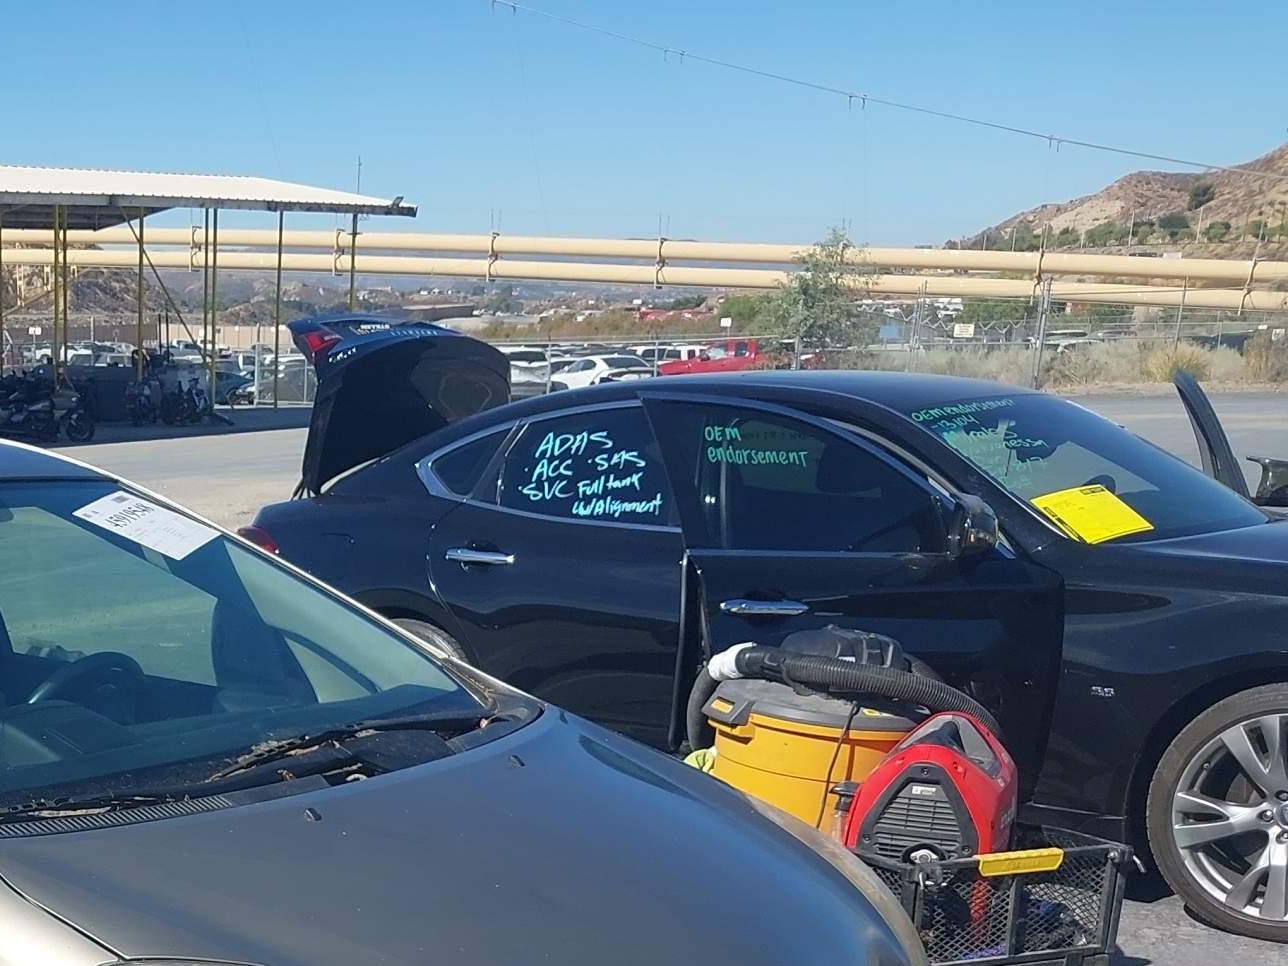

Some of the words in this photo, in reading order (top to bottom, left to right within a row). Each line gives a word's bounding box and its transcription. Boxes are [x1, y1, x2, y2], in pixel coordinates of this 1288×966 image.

[535, 431, 613, 458] ADAS
[704, 426, 742, 442] OEM
[531, 458, 574, 482] ACC
[594, 450, 646, 471] SAS
[707, 446, 808, 468] endorsement
[523, 480, 573, 501] SVC
[104, 502, 155, 528] 45919548
